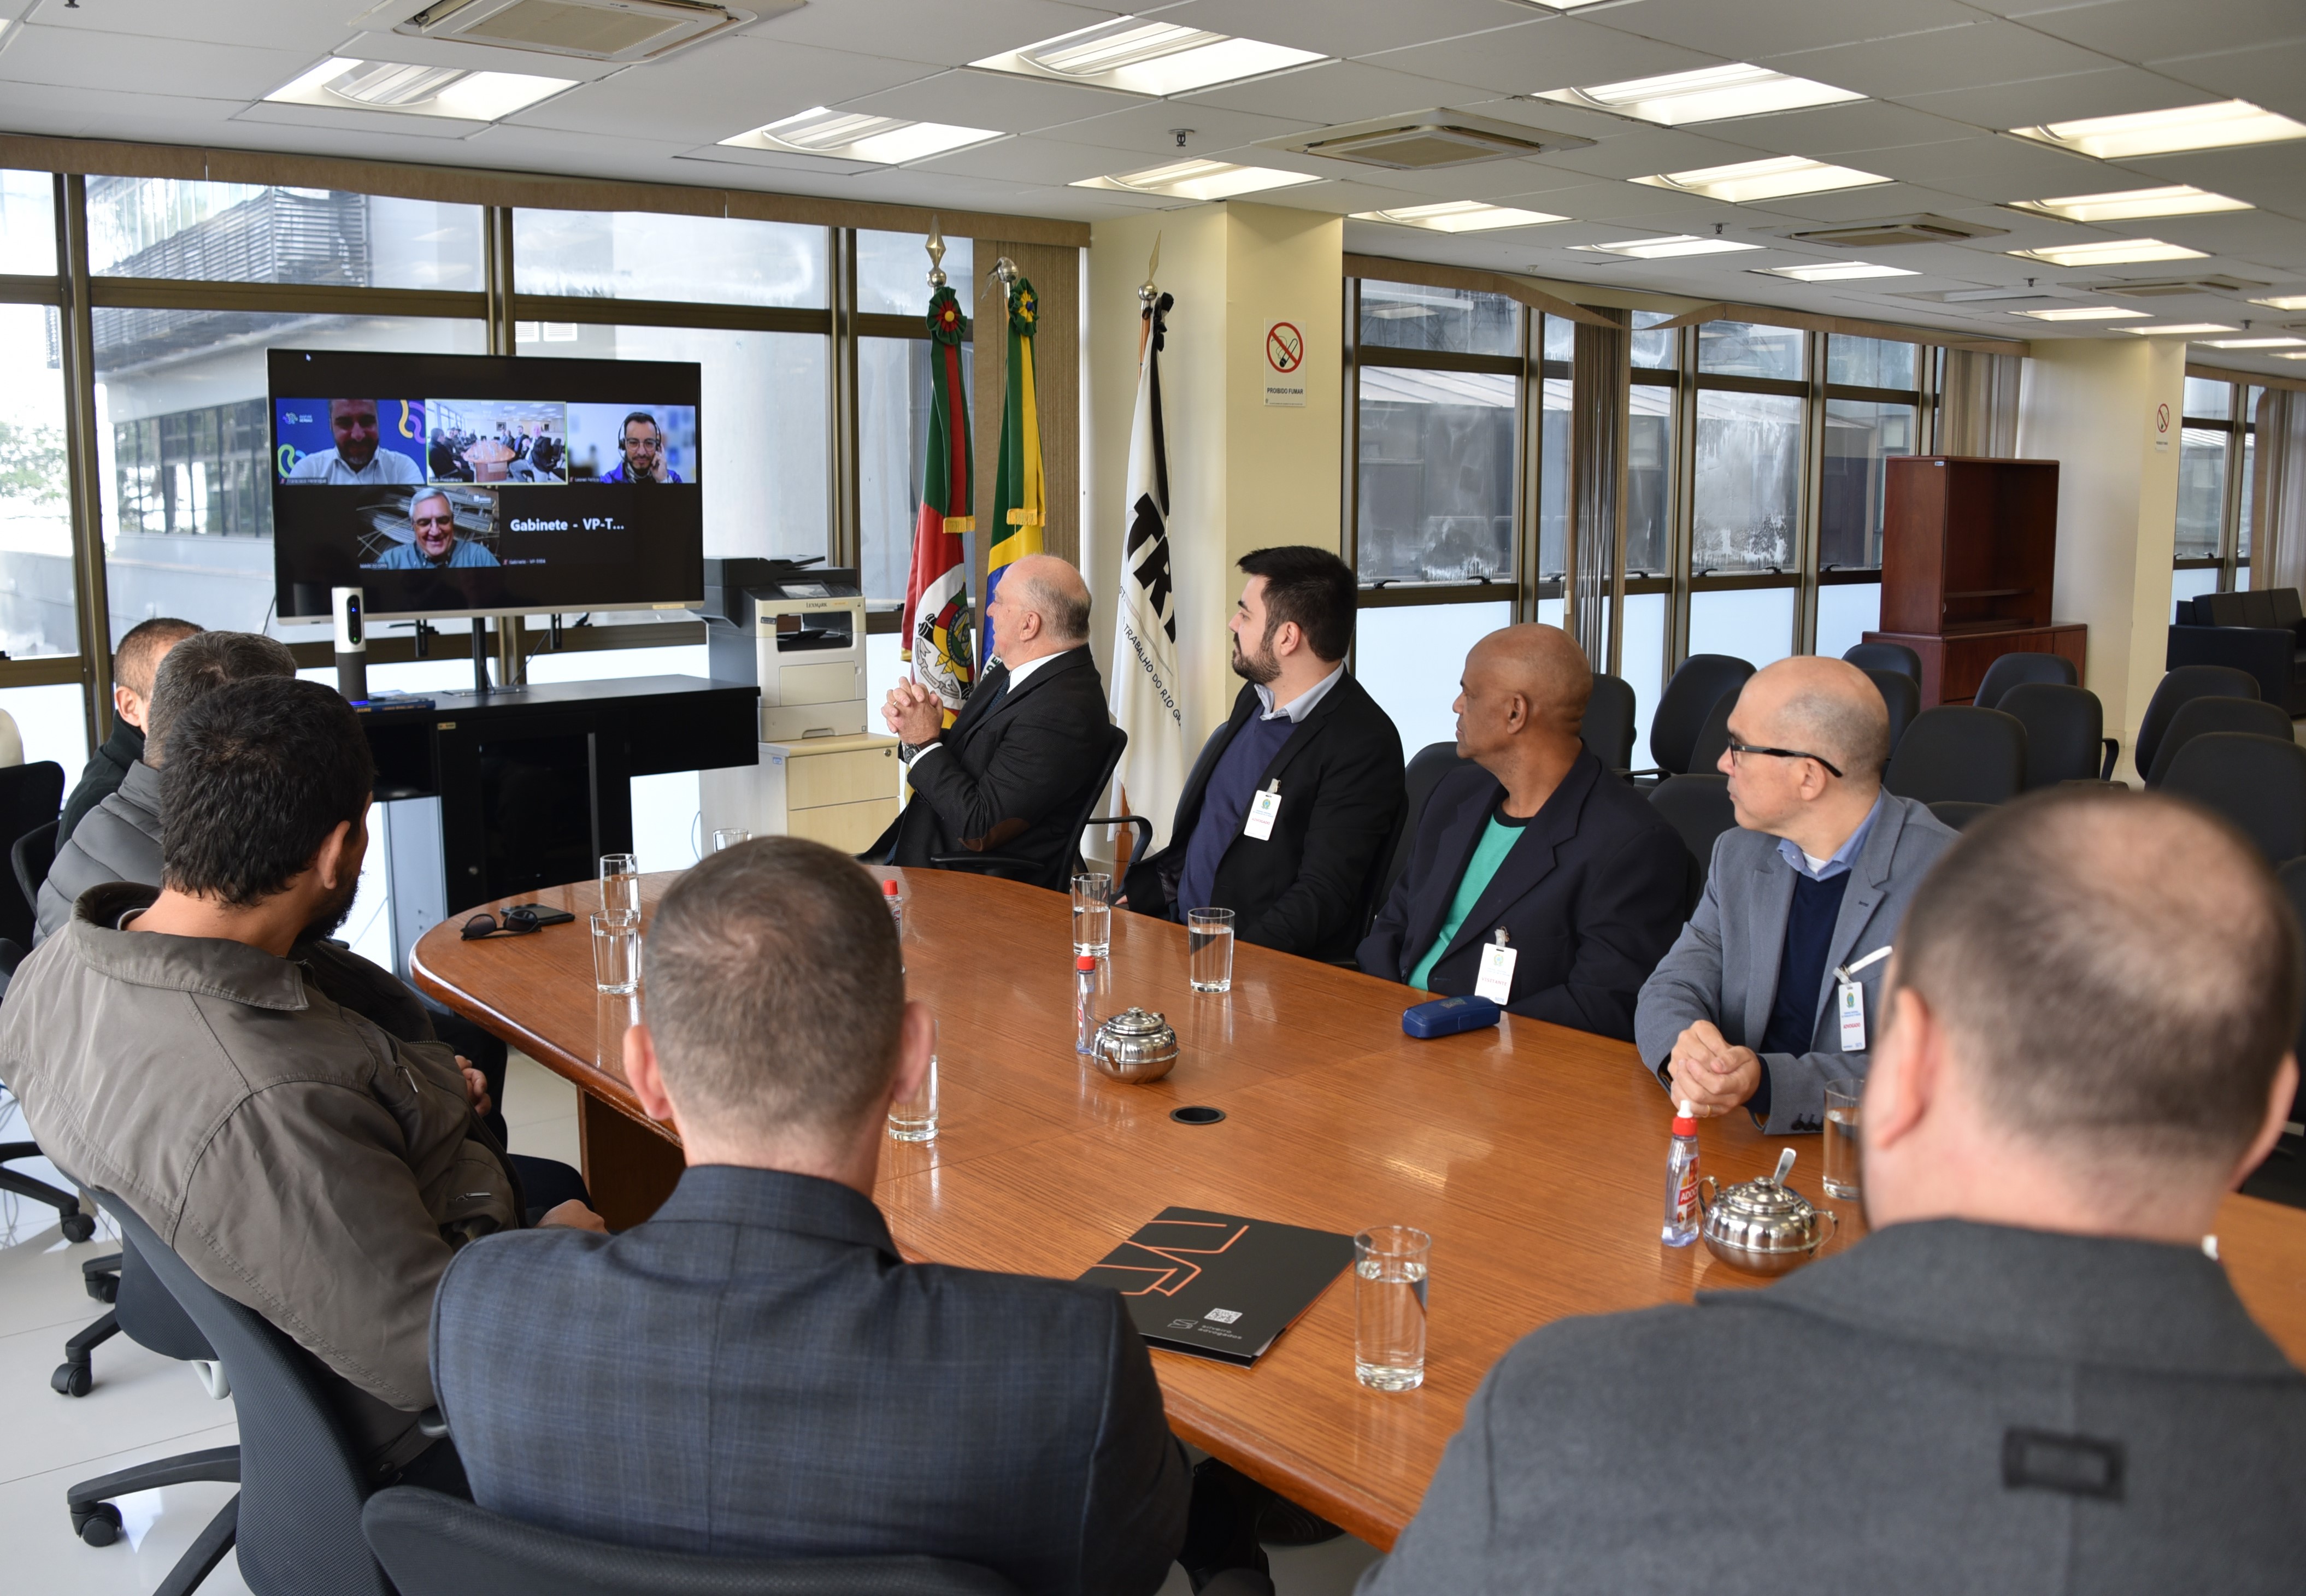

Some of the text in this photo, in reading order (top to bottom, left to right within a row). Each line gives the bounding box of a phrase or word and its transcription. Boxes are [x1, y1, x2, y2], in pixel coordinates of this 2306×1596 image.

[510, 518, 568, 531] Gabinete
[583, 518, 624, 530] VP-T...
[1124, 625, 1153, 673] TRABALHO
[1152, 673, 1162, 688] DO
[1160, 689, 1174, 708] RIO
[1482, 977, 1507, 986] VISITANTE
[1198, 1328, 1242, 1339] advogados
